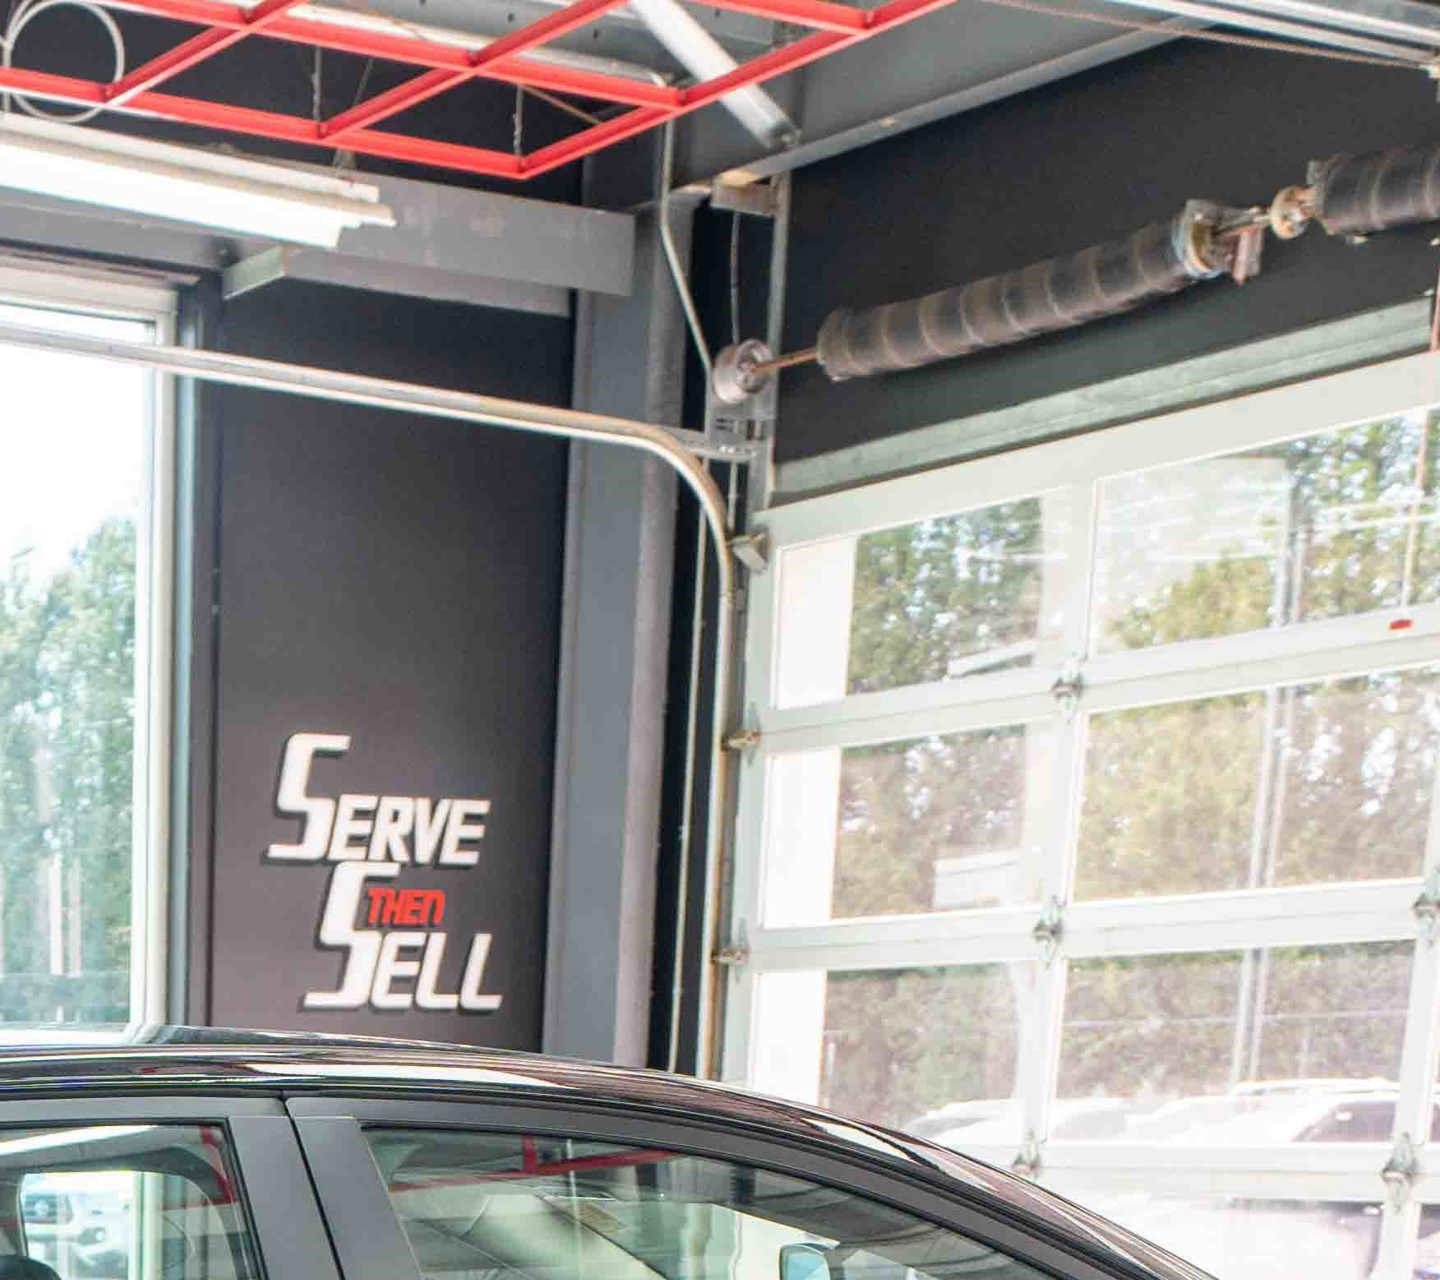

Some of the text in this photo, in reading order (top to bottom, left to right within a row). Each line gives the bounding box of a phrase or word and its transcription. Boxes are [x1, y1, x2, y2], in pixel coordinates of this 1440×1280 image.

[268, 733, 491, 865] SERVE
[303, 861, 503, 1010] SELL
[367, 888, 445, 925] THEN
